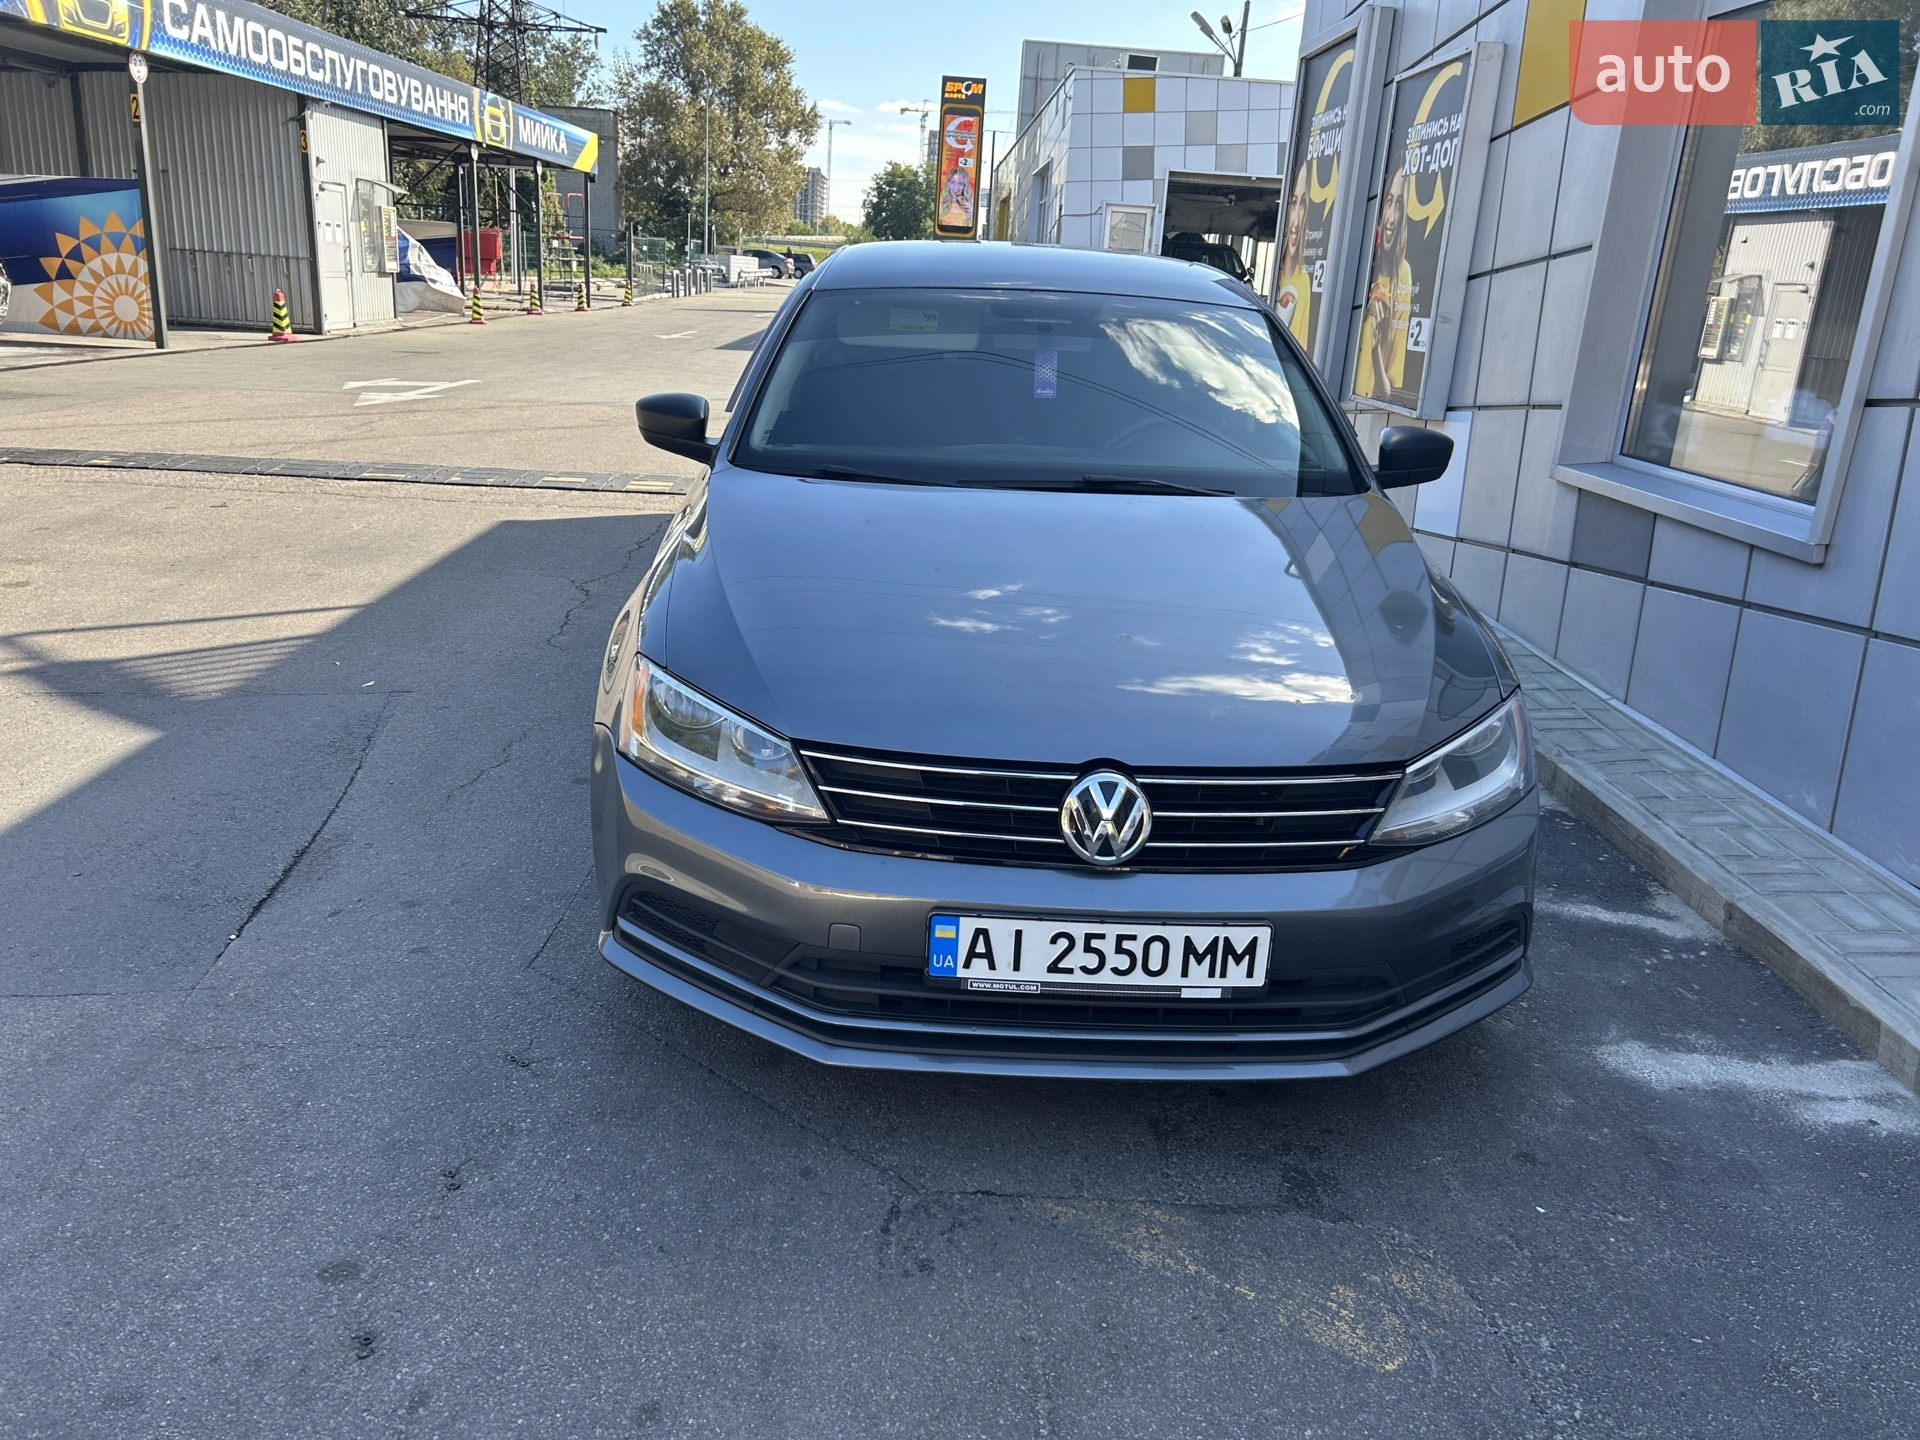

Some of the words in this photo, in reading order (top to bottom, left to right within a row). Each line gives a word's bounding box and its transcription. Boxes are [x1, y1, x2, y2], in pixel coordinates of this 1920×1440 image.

[162, 0, 470, 124] САМООБСЛУГОВУВАННЯ
[131, 96, 140, 119] 2
[301, 131, 308, 150] 3
[518, 115, 568, 155] МИЙКА
[1406, 116, 1449, 144] ЗУПИНИСЬ
[1449, 112, 1463, 133] НА
[1402, 136, 1460, 176] ХОТ-ДОГ
[933, 954, 955, 968] UA
[962, 927, 1023, 972] AI
[1047, 931, 1170, 978] 2550
[1181, 935, 1259, 979] MM
[971, 981, 1038, 991] WWW.MOTUL.COM
